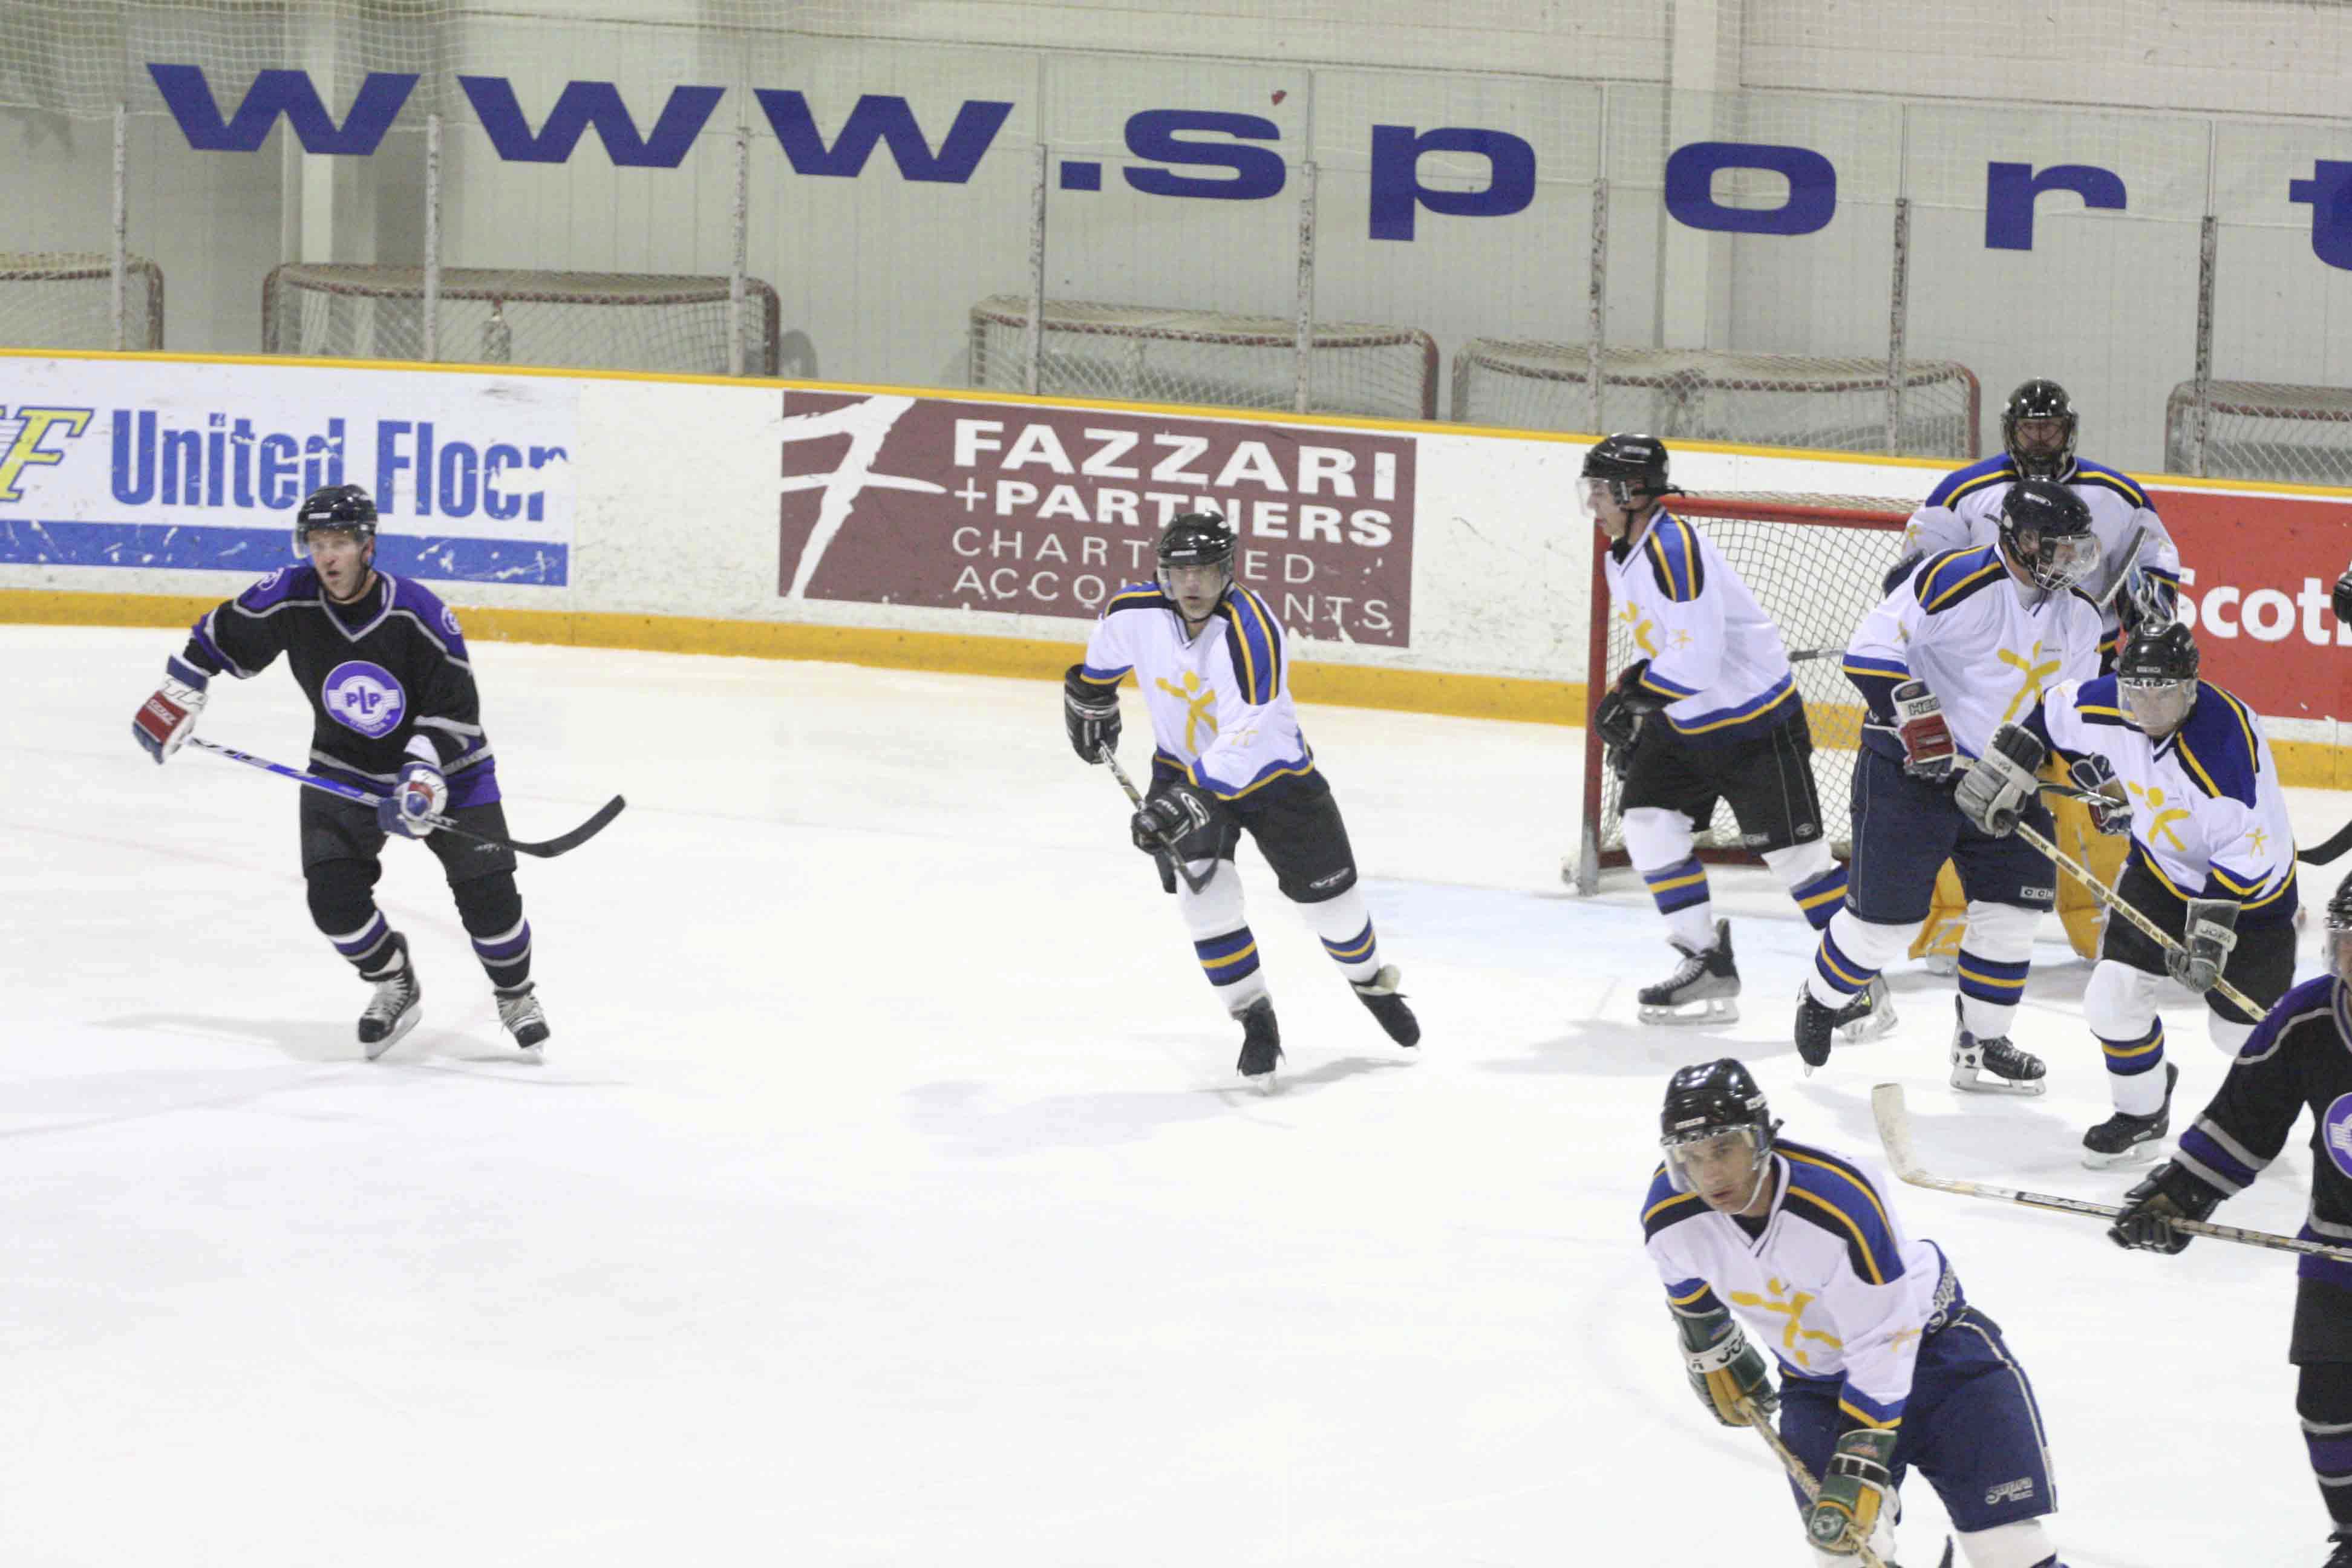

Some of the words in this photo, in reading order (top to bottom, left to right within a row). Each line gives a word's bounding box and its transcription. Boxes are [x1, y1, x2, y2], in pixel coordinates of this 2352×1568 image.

[112, 410, 345, 509] United
[954, 419, 1396, 500] FAZZARI
[952, 526, 1315, 584] CHARTED
[952, 566, 1391, 630] ACCONTS
[345, 685, 382, 714] PLP
